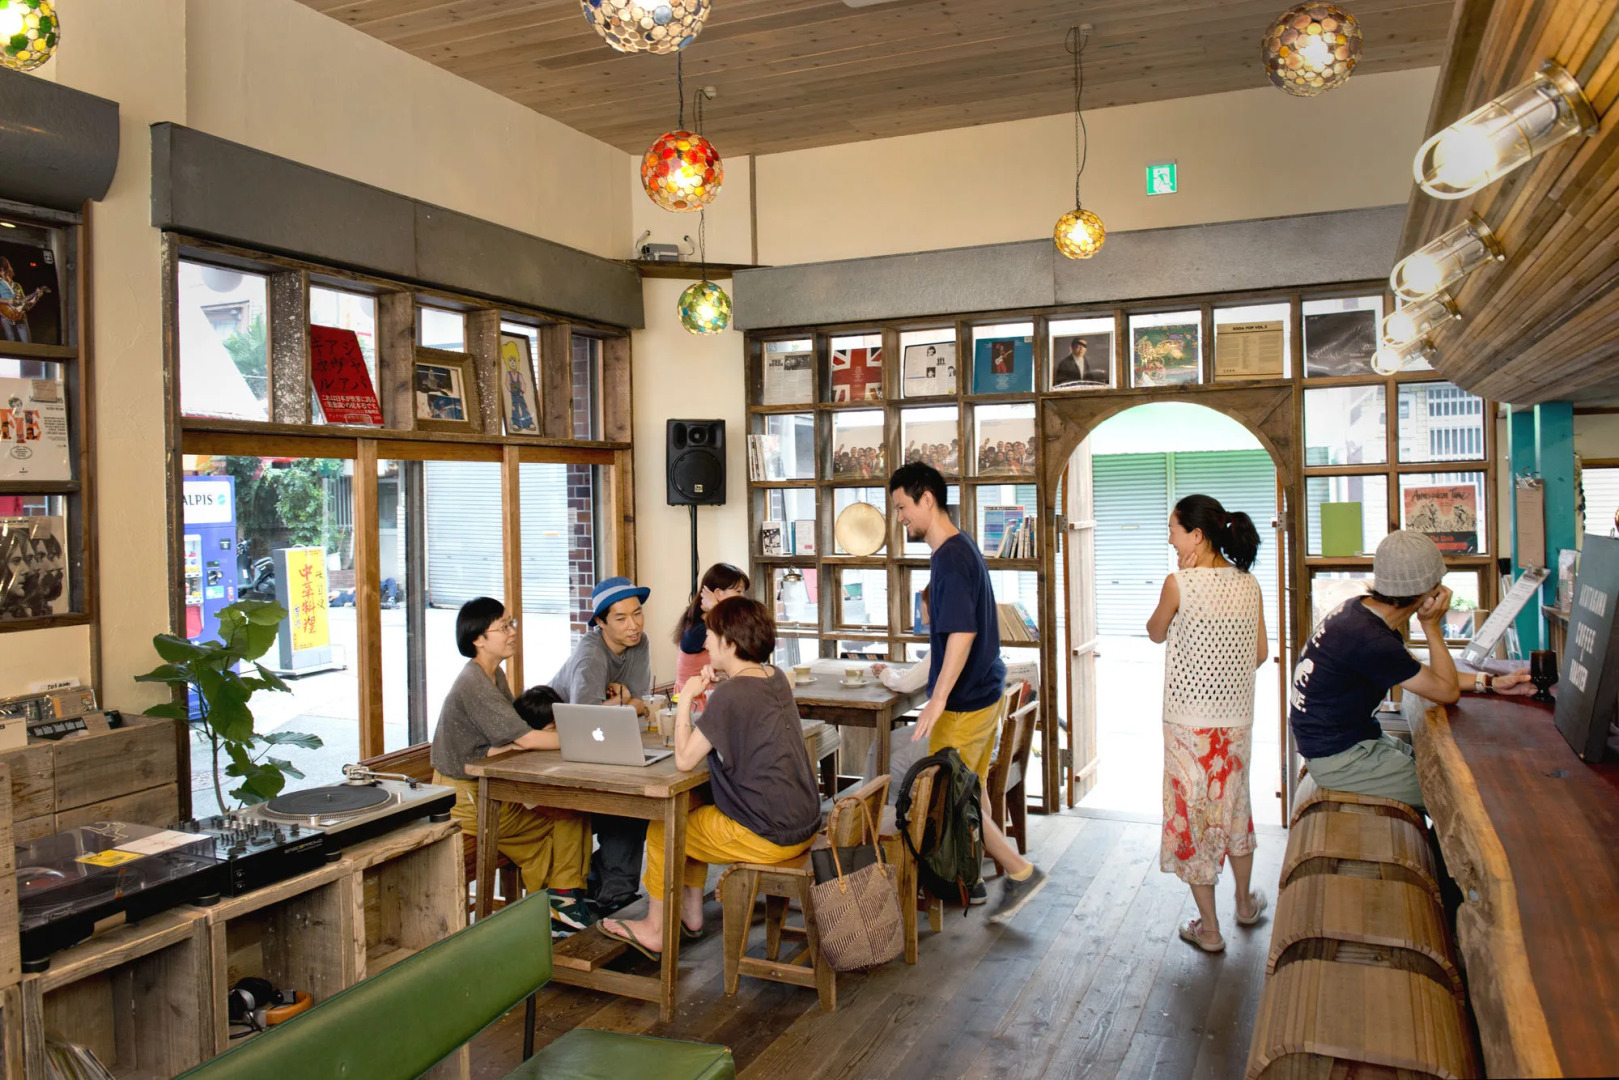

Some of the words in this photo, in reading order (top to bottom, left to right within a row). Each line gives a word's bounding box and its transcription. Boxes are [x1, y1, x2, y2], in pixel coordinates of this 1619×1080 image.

[298, 563, 316, 634] 中華料理
[1575, 621, 1596, 655] COFFEE
